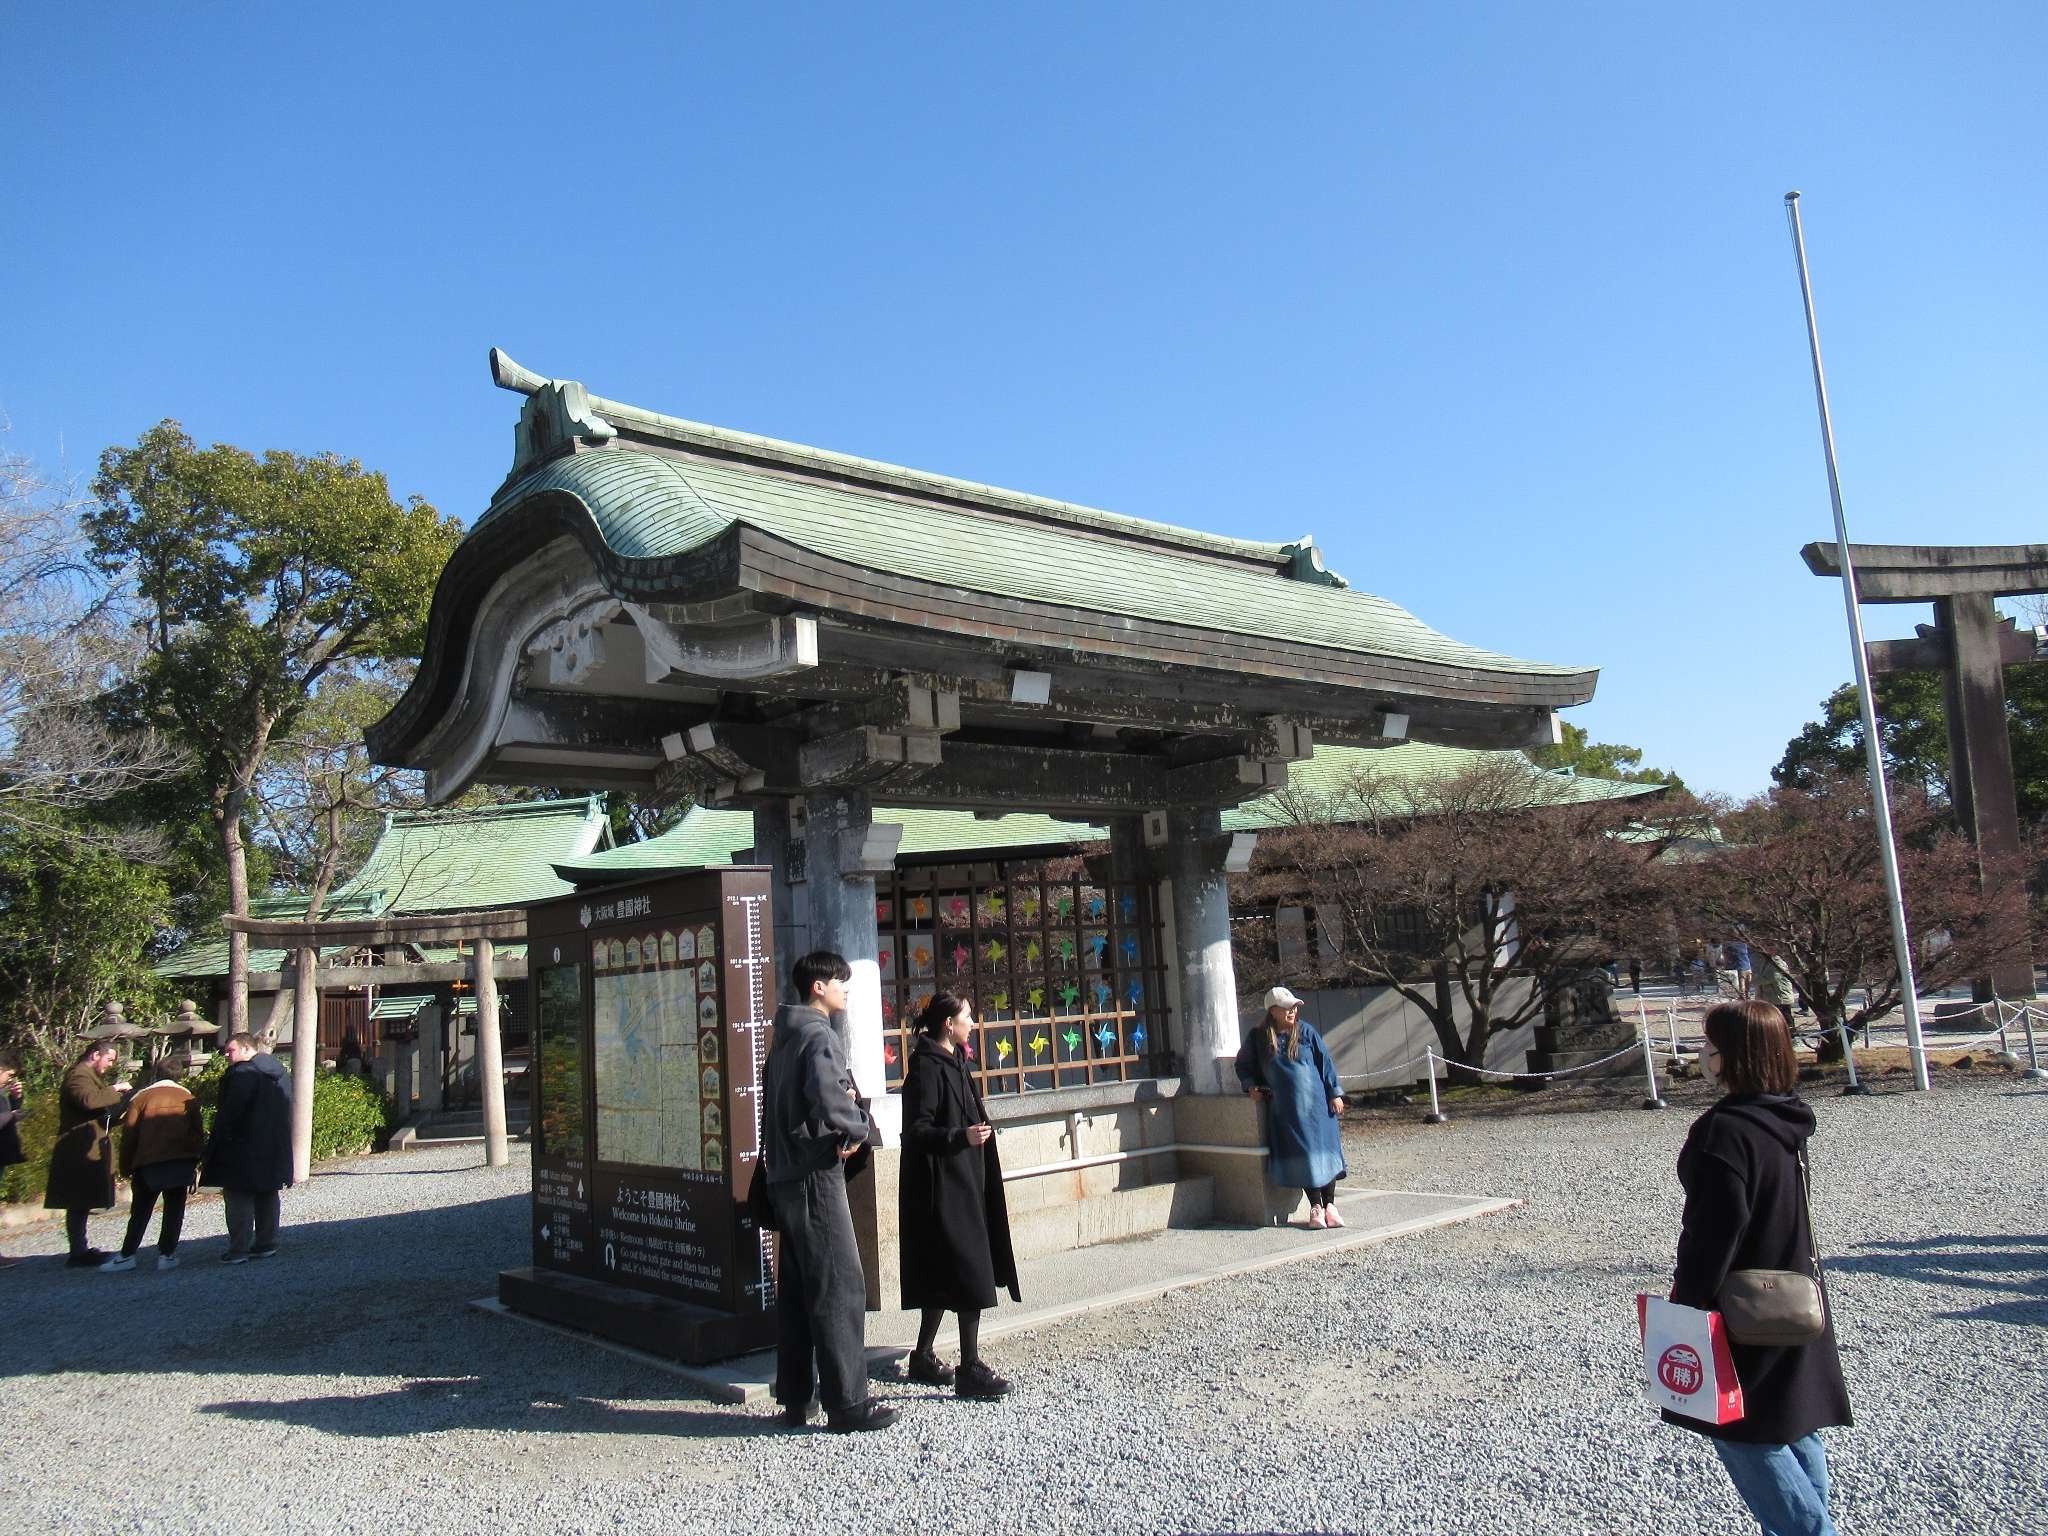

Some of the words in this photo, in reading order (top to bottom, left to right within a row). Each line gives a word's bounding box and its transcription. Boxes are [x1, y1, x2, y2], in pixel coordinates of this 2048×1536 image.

[611, 1206, 640, 1222] Welcome
[641, 1211, 648, 1224] to
[649, 1212, 673, 1230] Hokoku
[674, 1217, 697, 1233] Shrine
[672, 1257, 684, 1270] and
[1672, 1366, 1693, 1388] 勝
